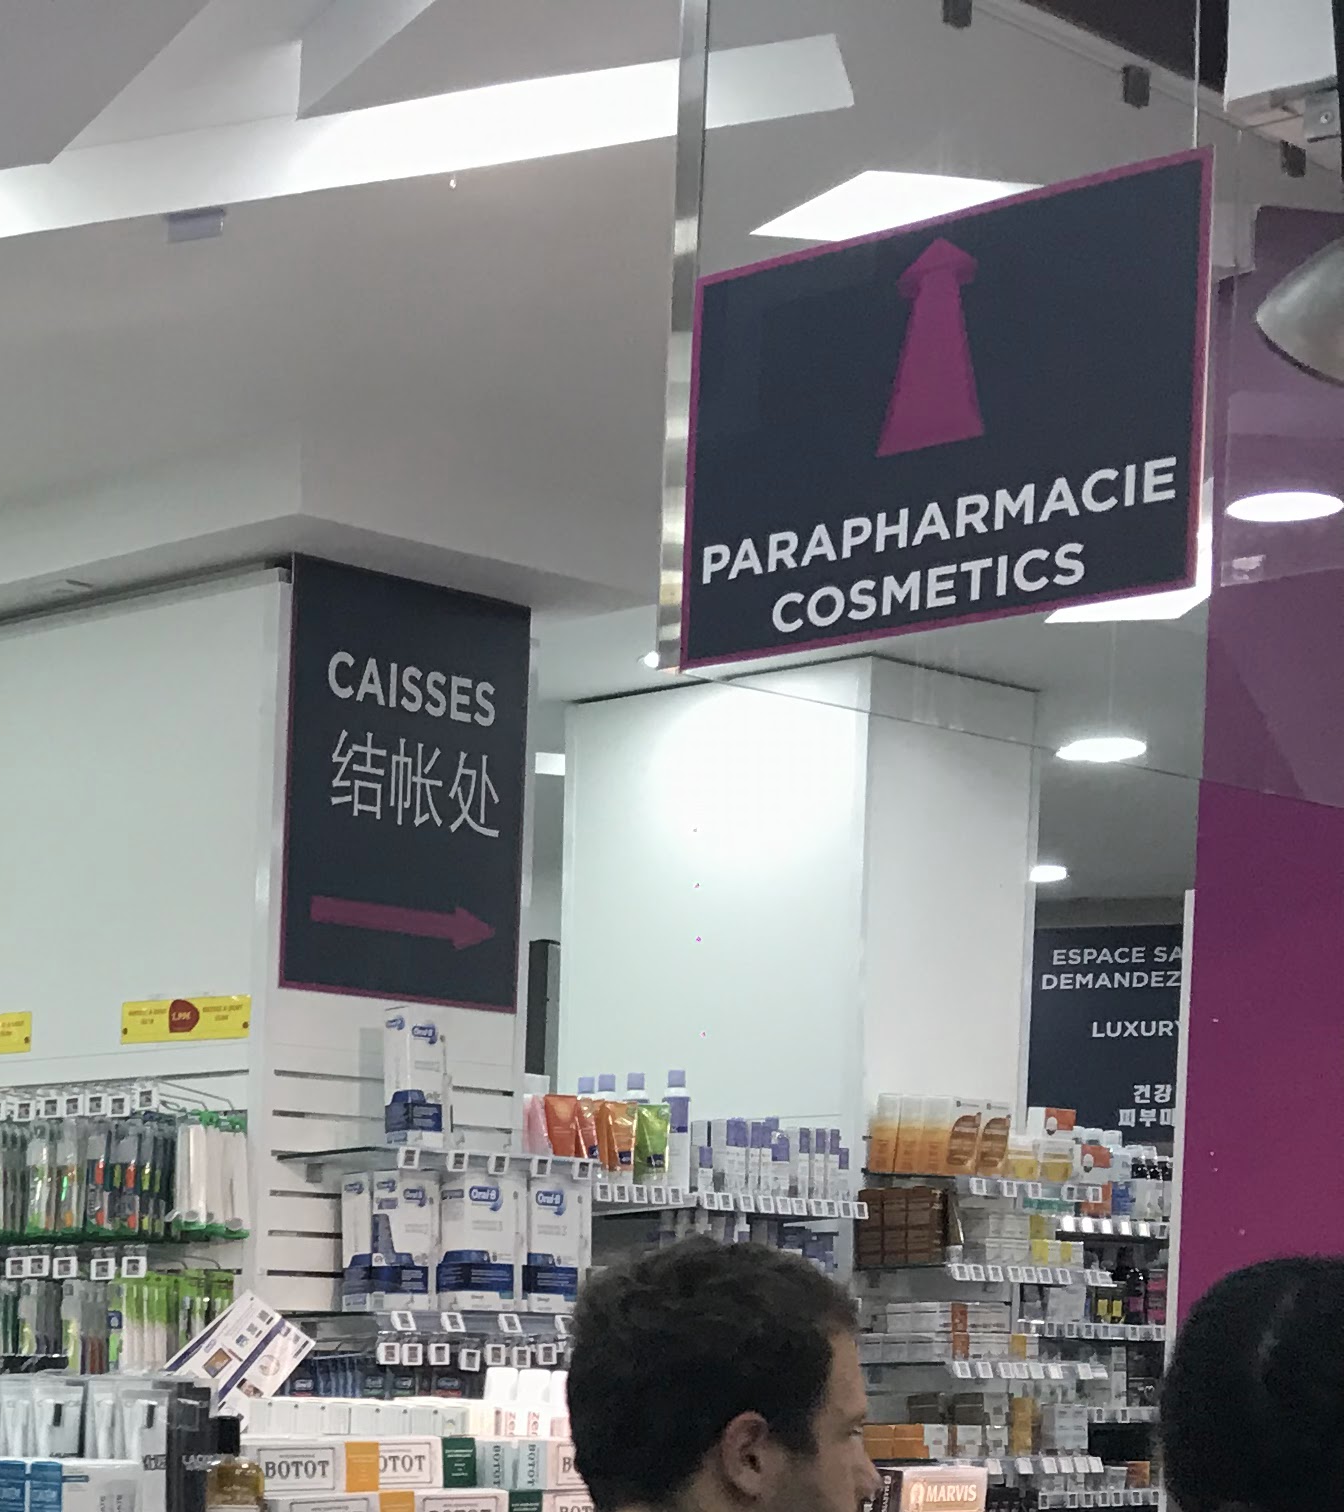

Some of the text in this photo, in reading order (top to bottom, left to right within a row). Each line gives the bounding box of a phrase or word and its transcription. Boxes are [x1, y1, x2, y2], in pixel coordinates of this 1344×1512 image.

[701, 455, 1177, 585] PARAPHARMACIE
[771, 542, 1086, 634] COSMETICS
[328, 651, 496, 728] CAISSES
[330, 728, 501, 838] 结帐处
[1052, 947, 1145, 966] ESPACE
[1041, 970, 1182, 990] DEMANDEZ
[471, 1187, 497, 1200] Oral-B
[537, 1190, 563, 1205] Oral-B
[264, 1460, 329, 1478] BOTOT
[926, 1484, 977, 1503] MARVIS
